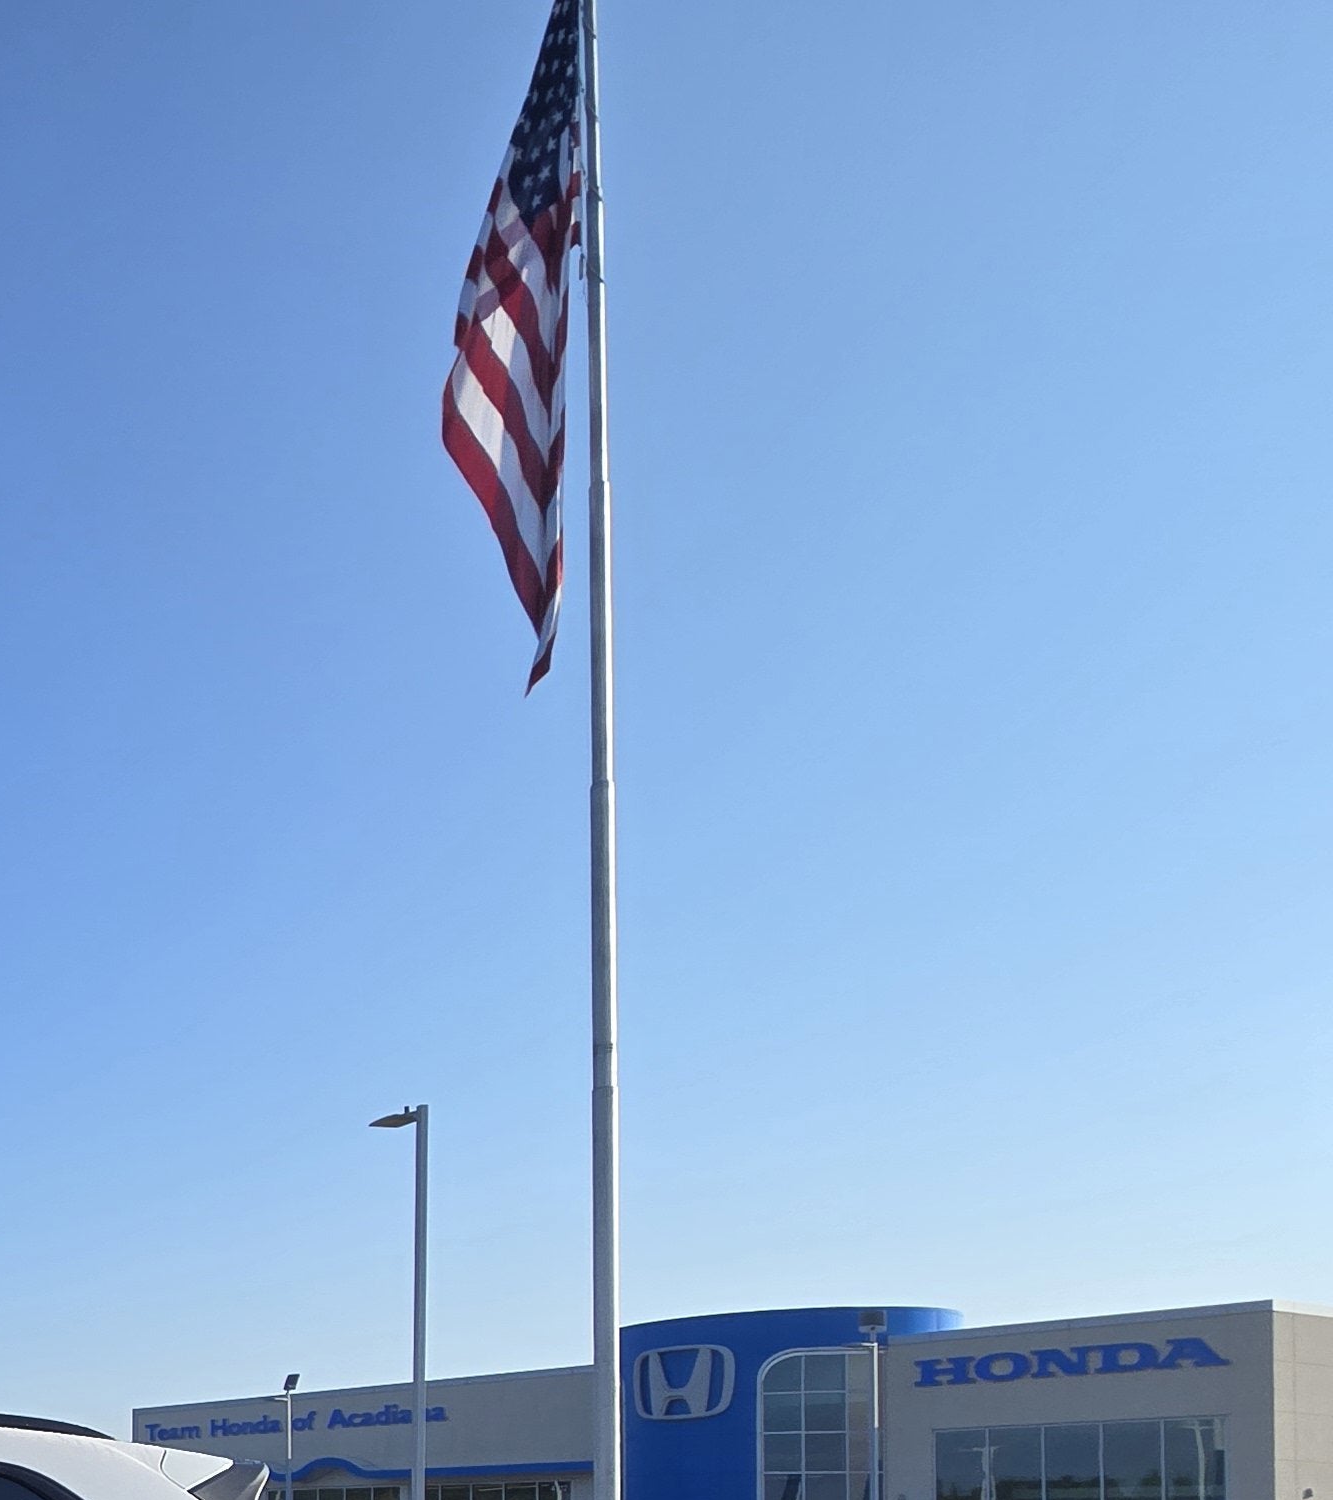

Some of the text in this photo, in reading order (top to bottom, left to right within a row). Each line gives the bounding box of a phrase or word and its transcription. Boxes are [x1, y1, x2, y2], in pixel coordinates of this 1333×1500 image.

[914, 1337, 1230, 1387] HONDA
[145, 1423, 201, 1442] Team
[210, 1414, 282, 1438] Honda
[292, 1410, 317, 1431] of
